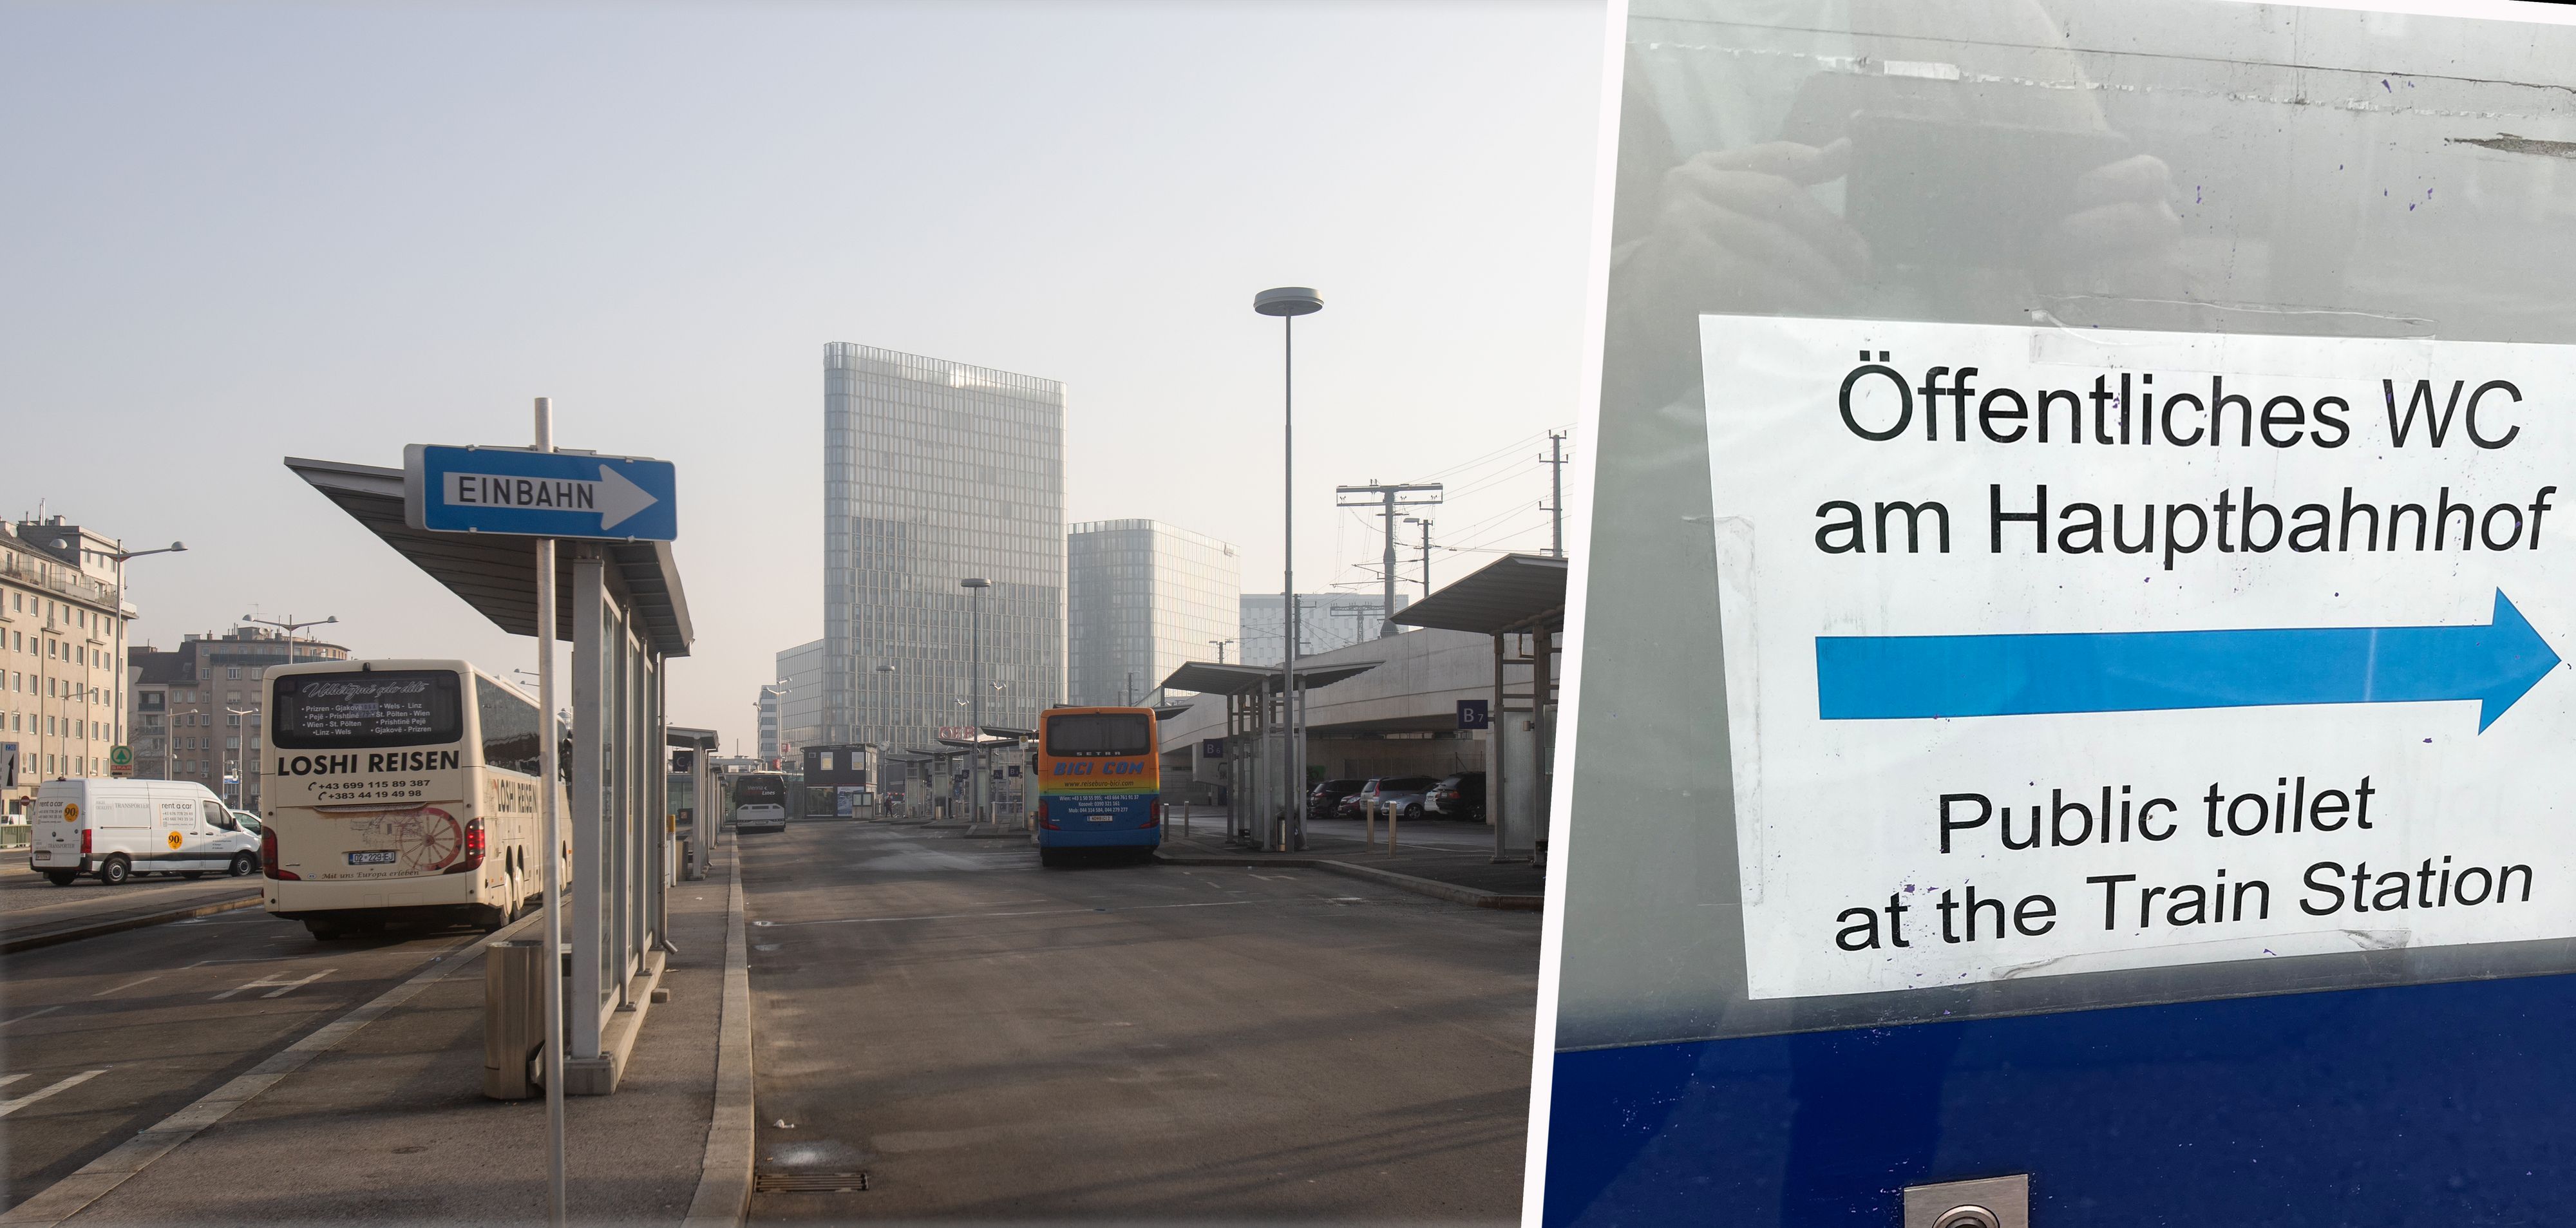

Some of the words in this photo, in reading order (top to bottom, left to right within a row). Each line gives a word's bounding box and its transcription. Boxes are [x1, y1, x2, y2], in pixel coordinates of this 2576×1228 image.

[1837, 350, 2351, 447] Öffentliches
[2383, 379, 2522, 449] WC
[459, 475, 594, 509] EINBAHN
[1815, 493, 1949, 554] am
[1989, 483, 2555, 571] Hauptbahnhof
[1464, 708, 1473, 723] B
[278, 754, 357, 776] LOSHI
[368, 750, 460, 773] REISEN
[1208, 744, 1213, 753] B
[1053, 762, 1094, 775] BICI
[1103, 761, 1144, 775] COM
[497, 779, 516, 813] LOSHI
[518, 782, 537, 813] REISEN
[1939, 788, 2178, 853] Public
[2204, 775, 2376, 838] toilet
[1835, 890, 1909, 952] at
[1937, 884, 2058, 944] the
[2087, 869, 2270, 930] Train
[2300, 855, 2534, 915] Station
